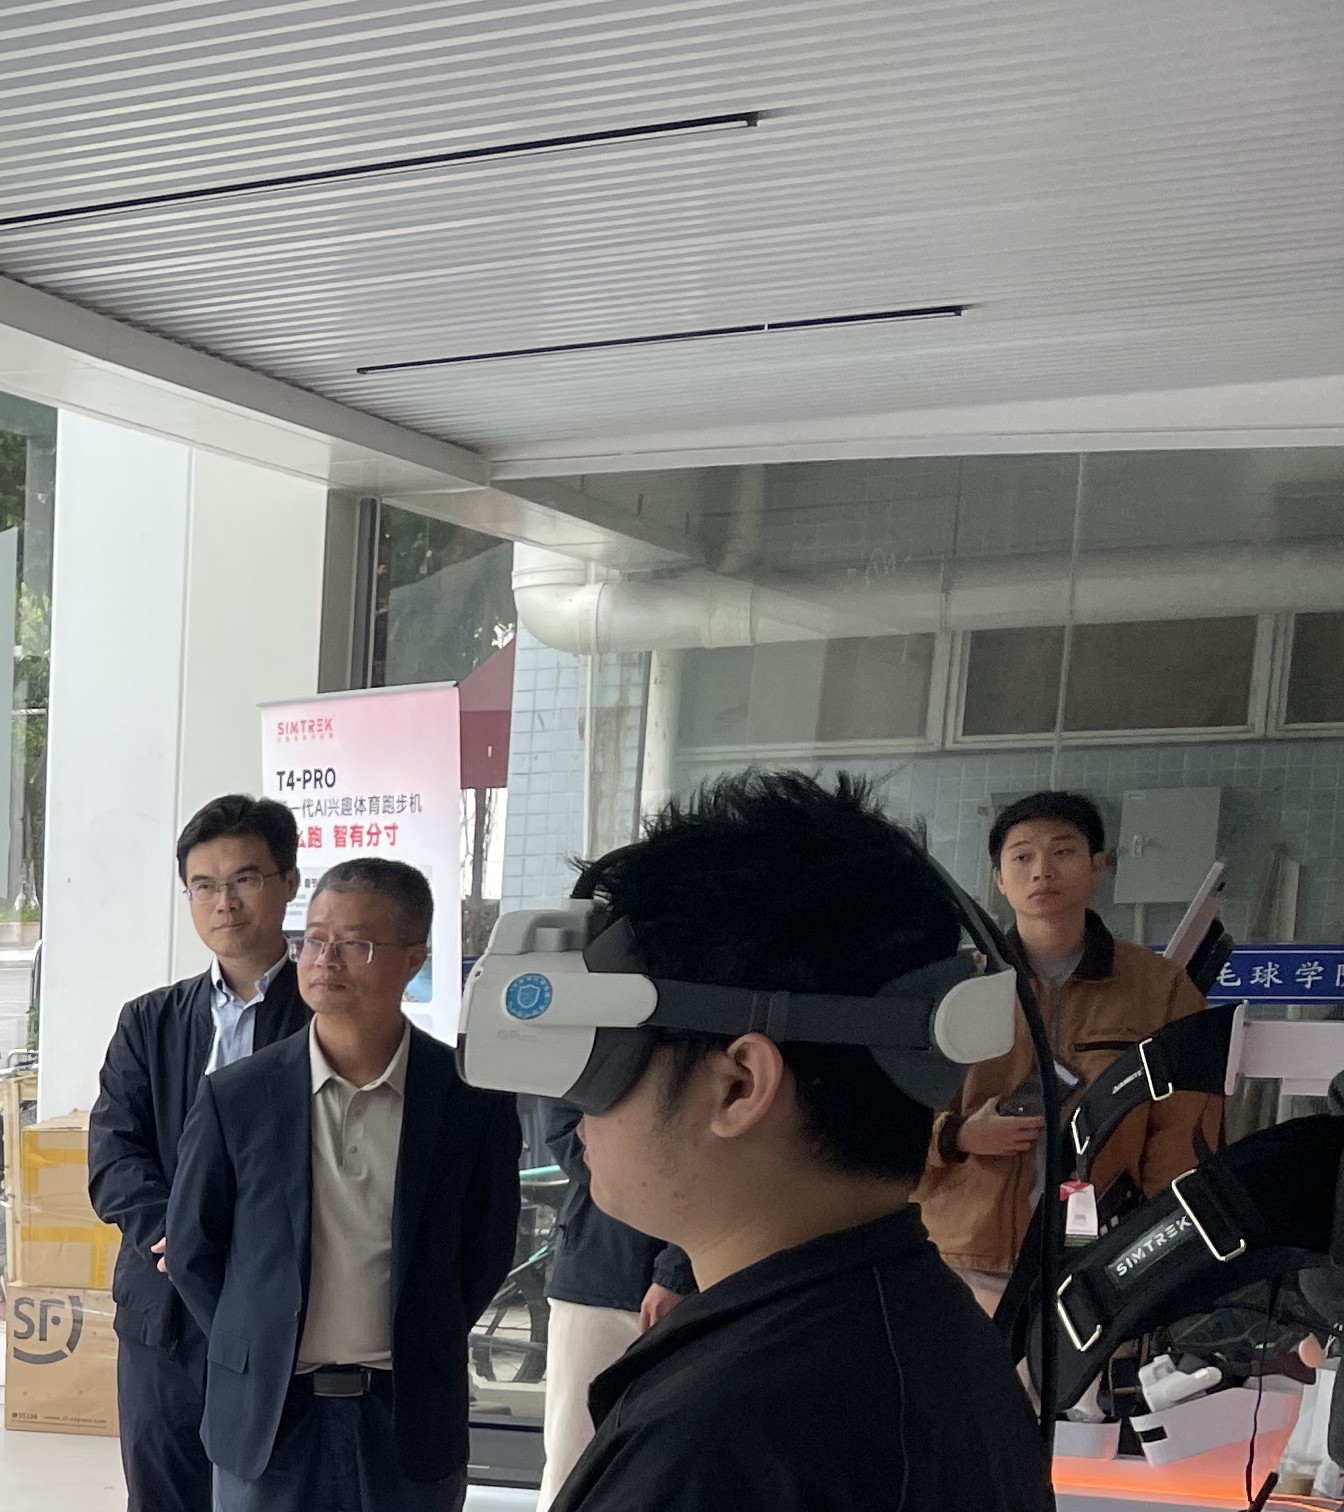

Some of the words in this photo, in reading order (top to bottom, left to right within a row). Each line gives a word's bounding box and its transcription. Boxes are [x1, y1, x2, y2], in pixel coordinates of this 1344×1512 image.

[277, 718, 333, 735] SIMTREK
[276, 767, 336, 791] T4-PRO
[284, 793, 423, 818] 一代AI兴趣体育跑步机
[333, 822, 399, 848] 智有分寸
[1116, 1215, 1192, 1276] SIMTREK
[14, 1297, 65, 1342] SF
